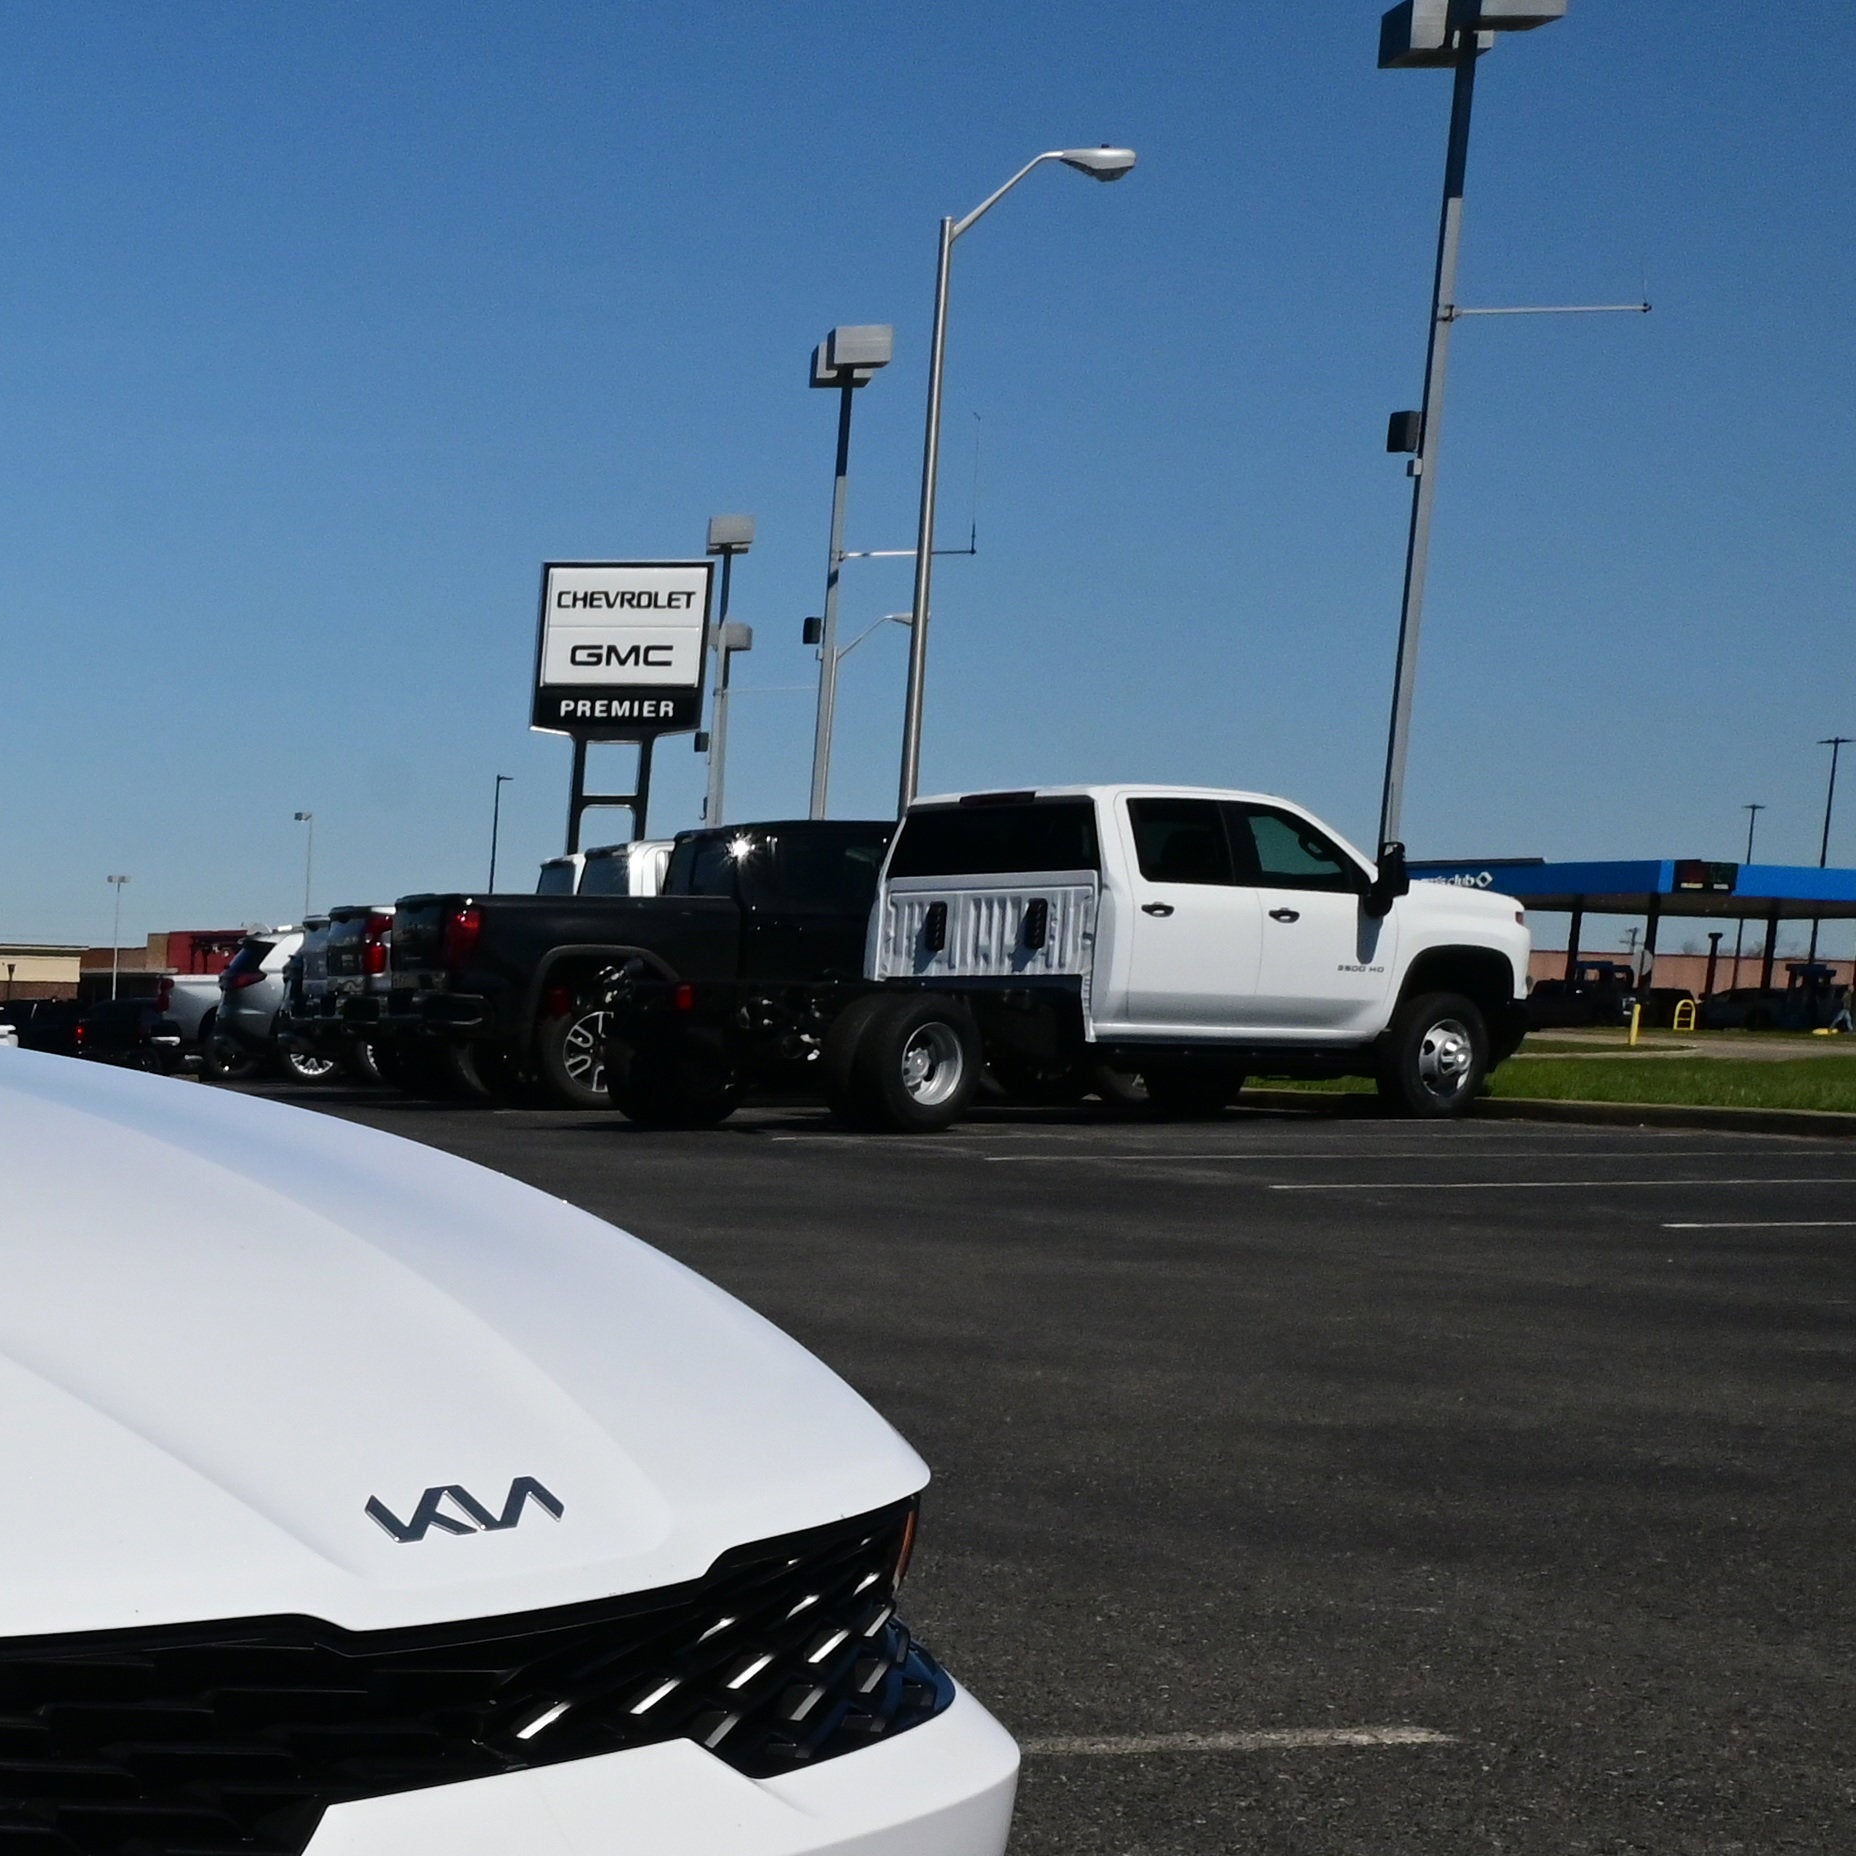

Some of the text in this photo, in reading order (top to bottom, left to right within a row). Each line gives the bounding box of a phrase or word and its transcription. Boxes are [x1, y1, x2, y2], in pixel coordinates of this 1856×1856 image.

[557, 591, 696, 609] CHEVROLET
[570, 645, 673, 666] GMC
[560, 700, 674, 717] PREMIER
[365, 1476, 565, 1543] KIA
